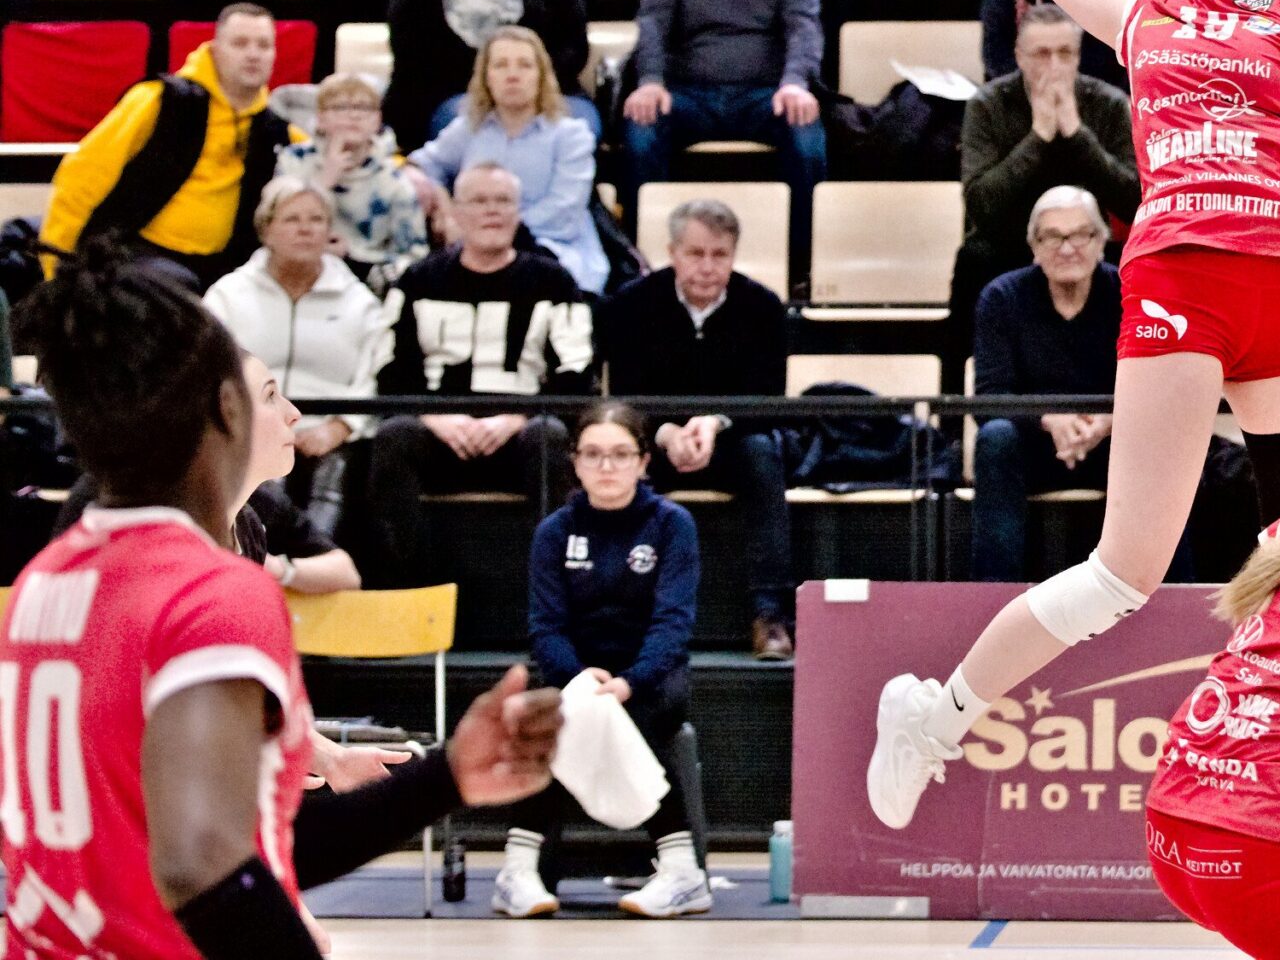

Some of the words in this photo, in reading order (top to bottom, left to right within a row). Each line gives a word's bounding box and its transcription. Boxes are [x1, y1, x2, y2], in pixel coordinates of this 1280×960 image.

[1148, 50, 1271, 79] Säästöpankki
[1196, 171, 1262, 185] VIHANNES
[1135, 322, 1169, 341] salo
[962, 696, 1169, 773] Salo
[0, 660, 96, 851] 10
[1001, 782, 1144, 813] HOTE
[1146, 820, 1182, 866] ORA
[900, 863, 975, 878] HELPPOA
[978, 863, 996, 878] JA
[1000, 864, 1100, 880] VAIVATONTA
[1102, 865, 1154, 880] MAJOI
[1186, 858, 1243, 875] KEITTIÖT
